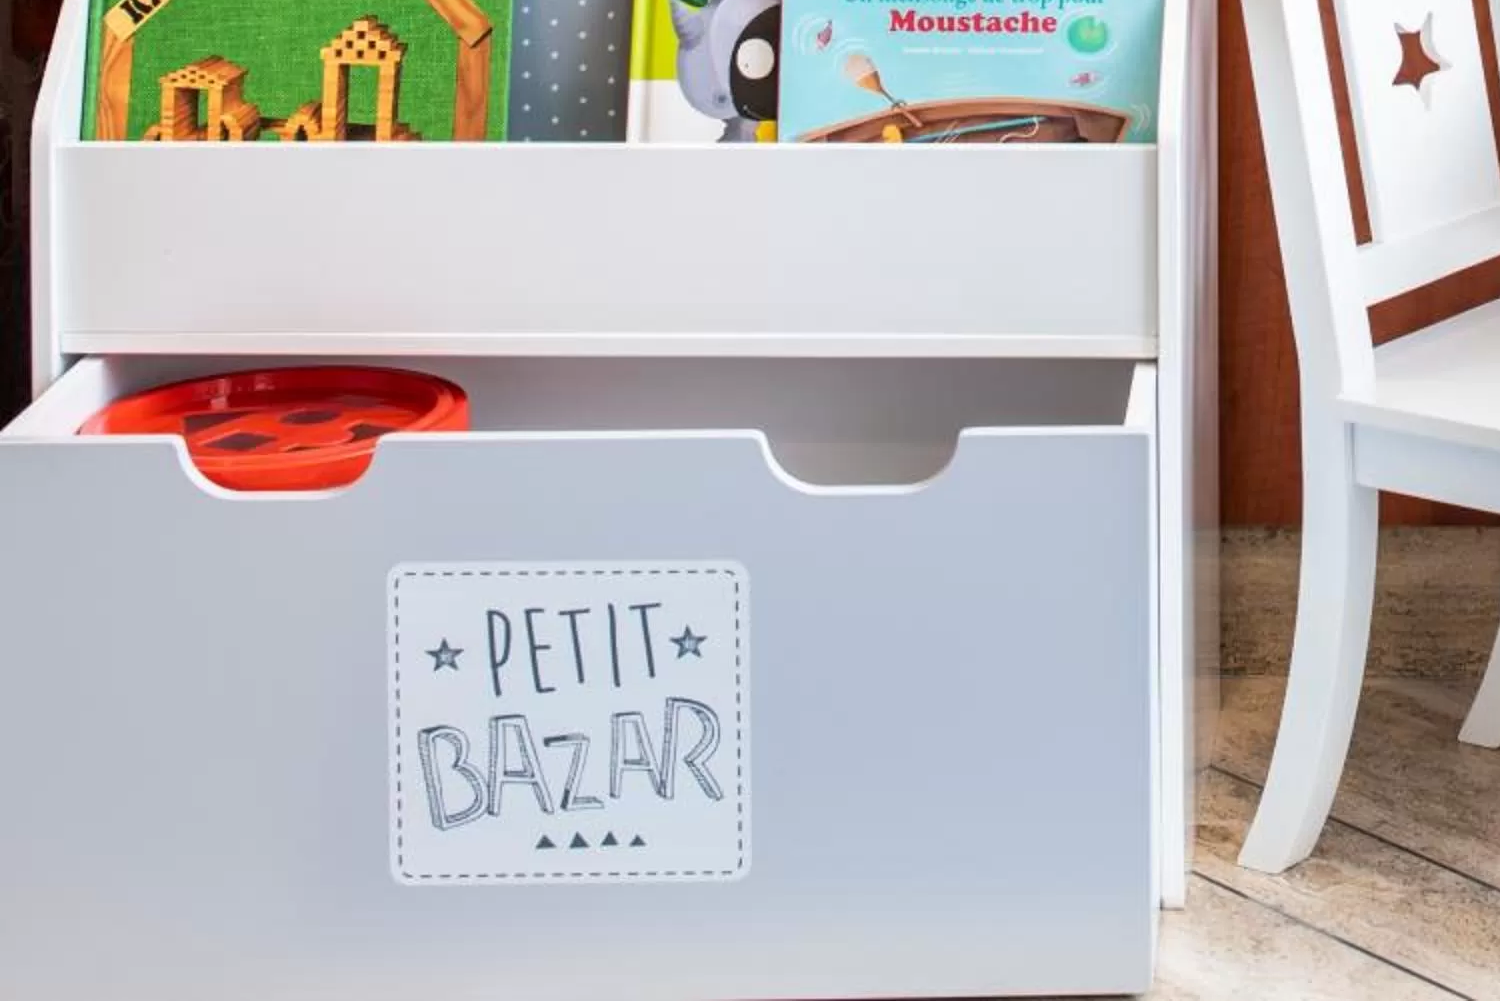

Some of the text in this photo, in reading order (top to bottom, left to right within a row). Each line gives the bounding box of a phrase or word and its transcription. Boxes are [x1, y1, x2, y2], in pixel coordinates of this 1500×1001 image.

[889, 9, 1057, 33] Moustache
[486, 602, 662, 697] PETIT
[417, 696, 724, 832] BAZAR
